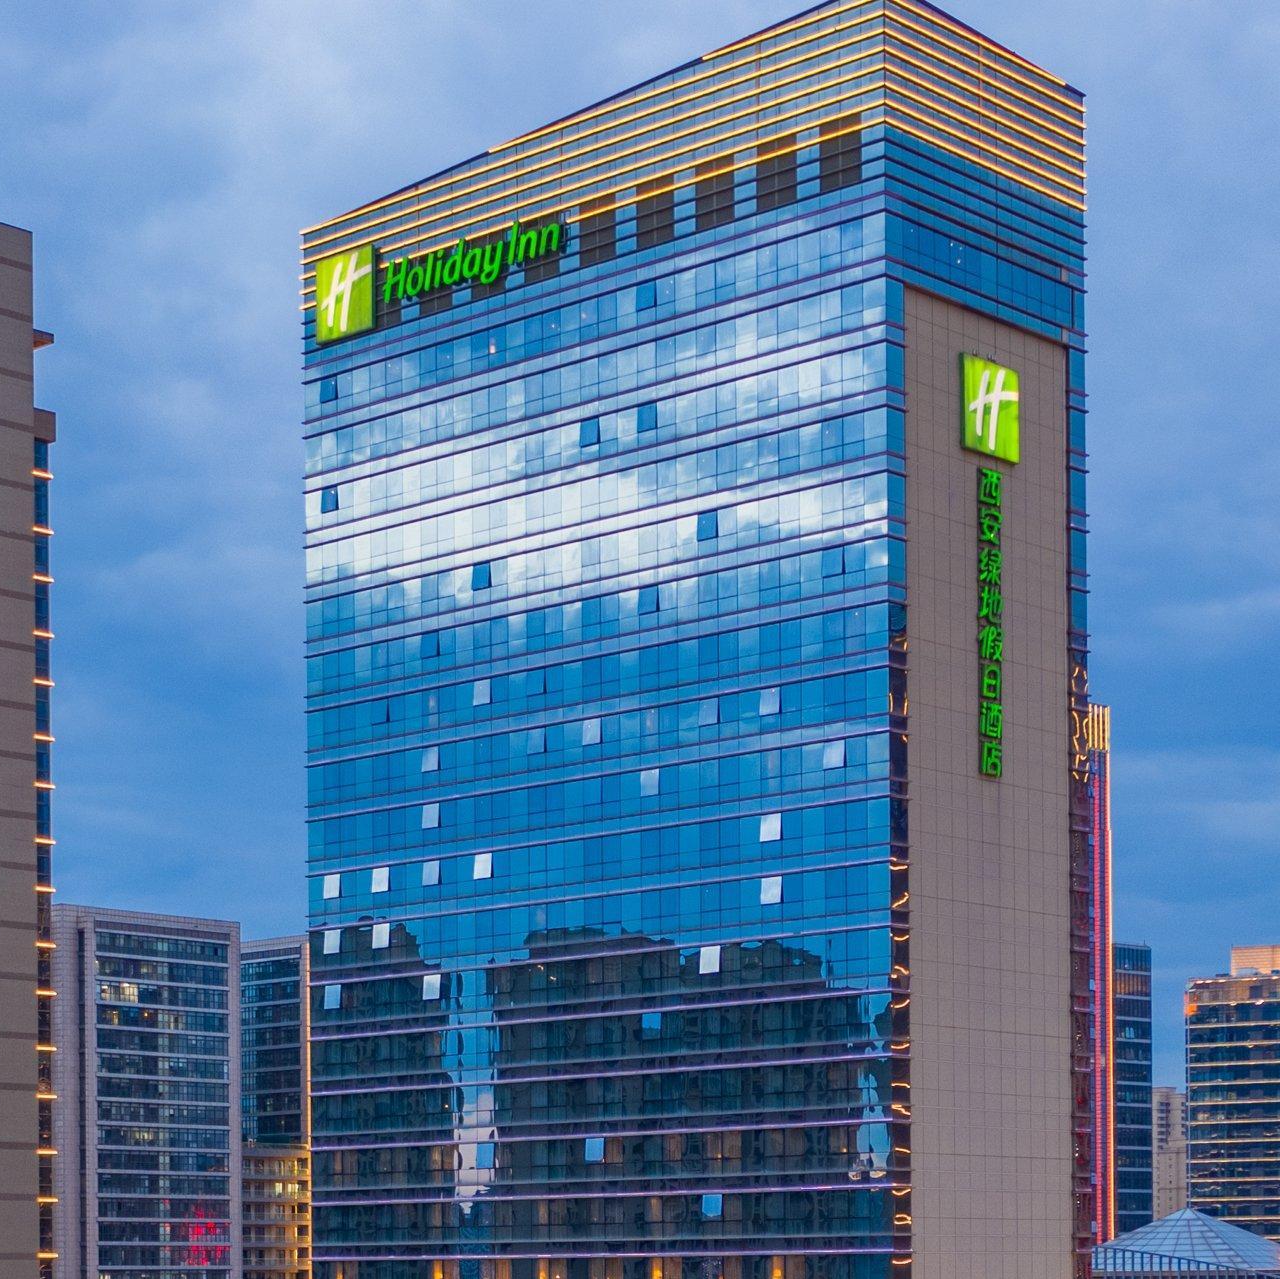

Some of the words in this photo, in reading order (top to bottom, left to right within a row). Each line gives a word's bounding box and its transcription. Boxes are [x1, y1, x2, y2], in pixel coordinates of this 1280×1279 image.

[383, 238, 503, 304] Holiday
[508, 220, 561, 266] Inn
[978, 467, 1005, 779] 西安绿地假日酒店
